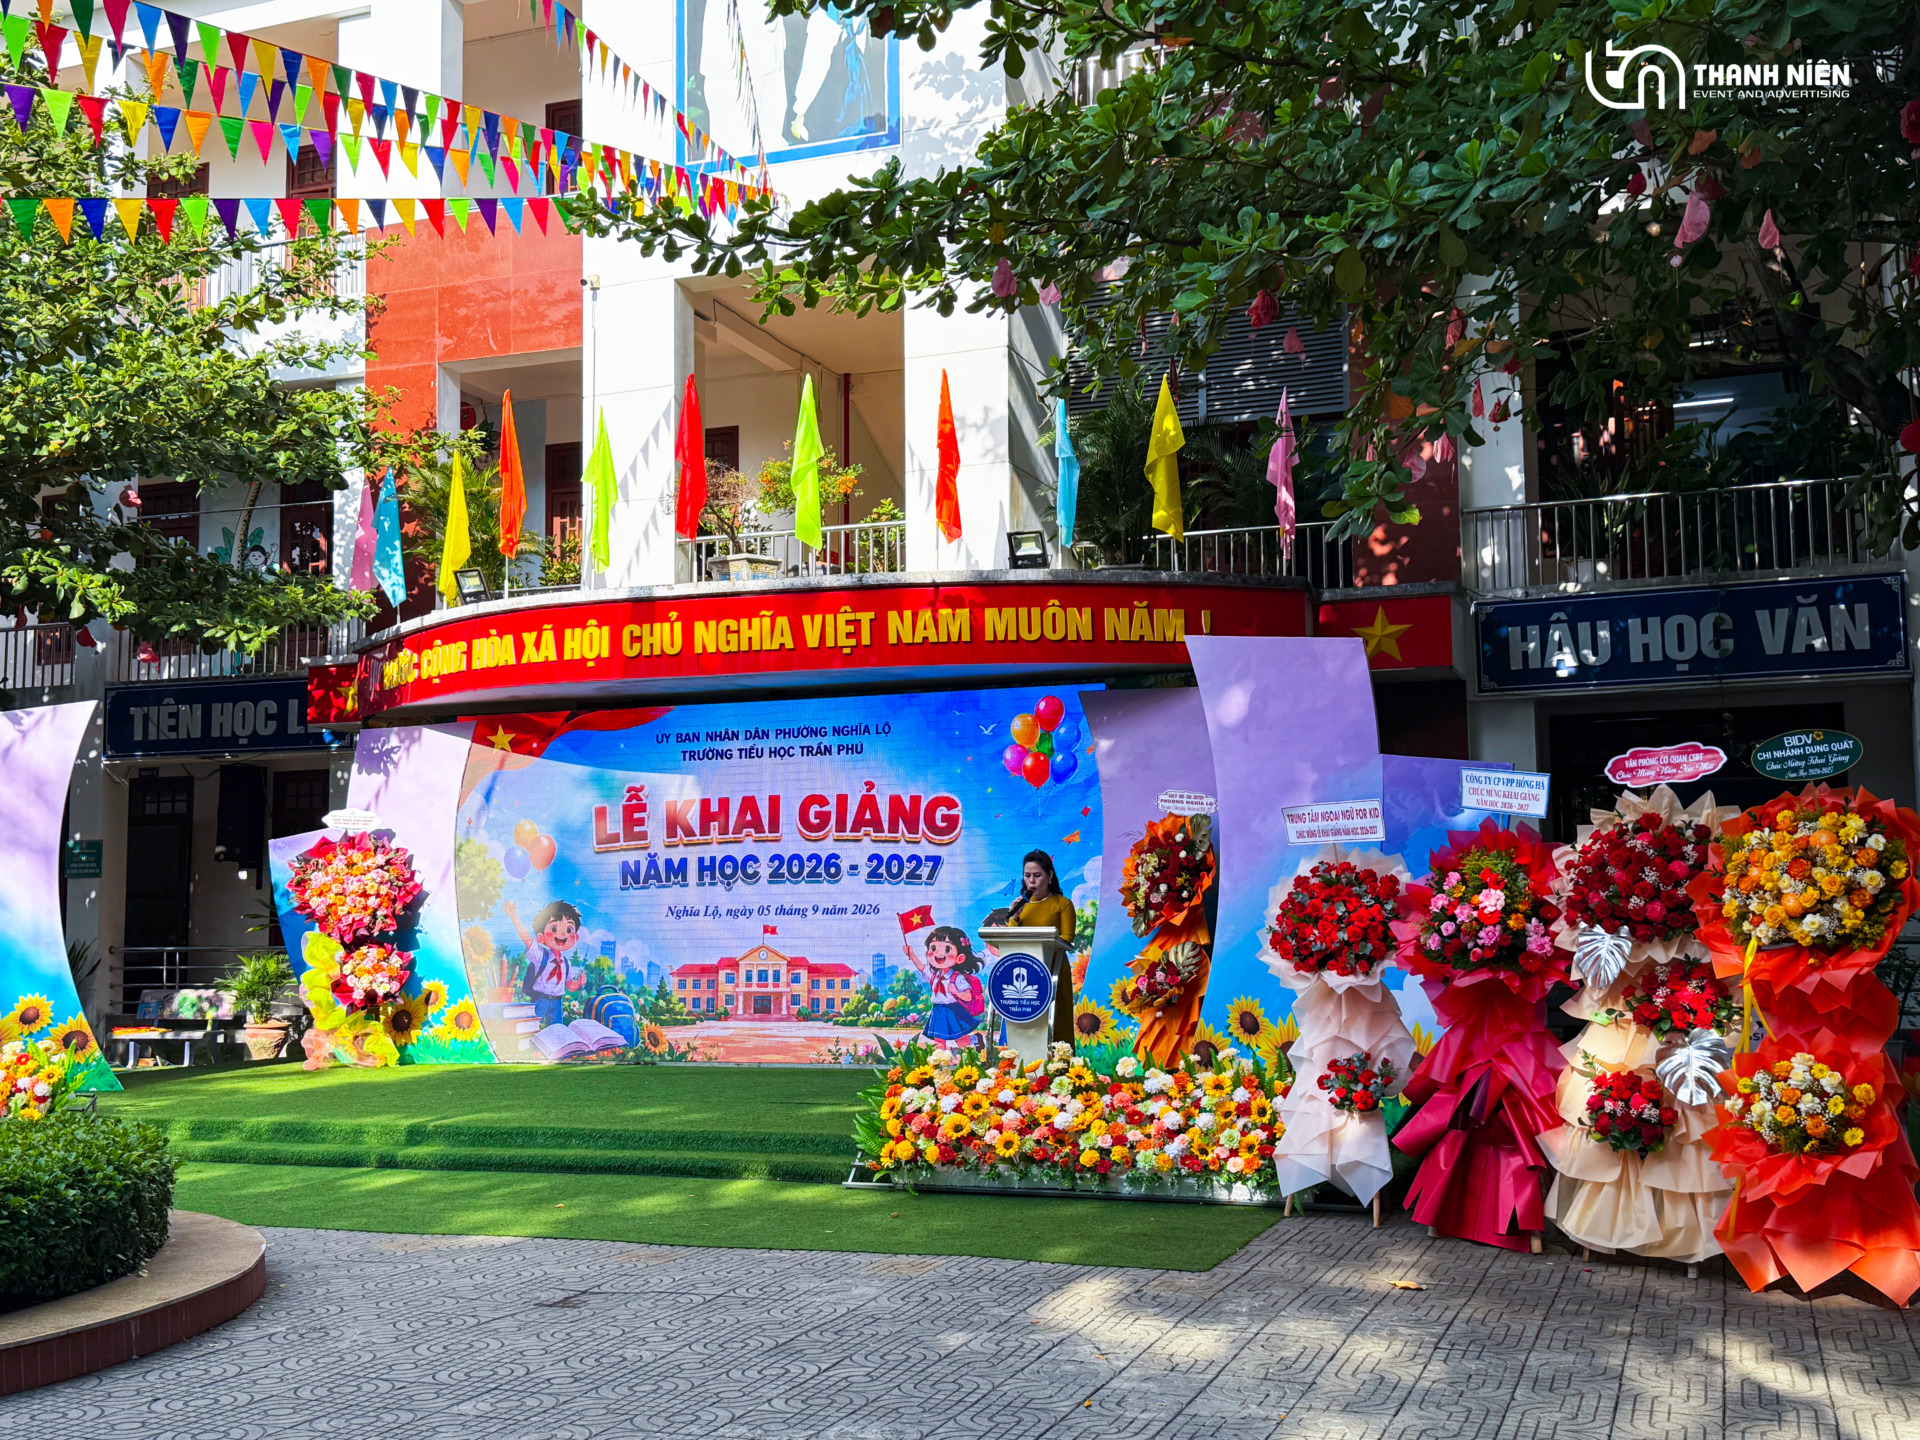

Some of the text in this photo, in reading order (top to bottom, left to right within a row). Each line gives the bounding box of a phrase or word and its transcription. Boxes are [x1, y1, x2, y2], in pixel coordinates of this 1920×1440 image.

[421, 640, 467, 684] CỘNG
[472, 629, 515, 670] HÒA
[521, 624, 556, 663] XÃ
[564, 619, 609, 667] HỘI
[622, 611, 682, 658] CHỦ
[694, 610, 794, 654] NGHĨA
[802, 606, 875, 654] VIỆT
[888, 608, 971, 644] NAM
[985, 599, 1093, 642] MUÔN
[1104, 600, 1186, 642] NĂM
[1628, 612, 1734, 671] HỌC
[1755, 595, 1871, 655] VĂN
[130, 698, 323, 744] TIÊN HỌC L
[656, 721, 891, 744] ỦY BAN NHÂN DÂN PHƯỜNG NGHĨA LỘ
[1783, 733, 1813, 747] BIDV
[681, 741, 864, 762] TRƯỜNG TIỂU HỌC TRẦN PHÚ
[1757, 739, 1854, 760] CHI NHÁNH DUNG QUẤT
[1625, 758, 1637, 768] VĂN
[1638, 757, 1658, 767] PHÒNG
[1669, 755, 1687, 764] QUAN
[1766, 760, 1782, 771] Chúc
[1465, 773, 1483, 784] CÔNG
[1484, 776, 1493, 785] TY
[1493, 777, 1501, 786] CP
[1501, 778, 1515, 787] VPP
[1468, 786, 1485, 796] CHÚC
[1502, 790, 1519, 800] KHAI
[1476, 798, 1488, 807] NĂM
[1500, 801, 1513, 810] 2026
[1517, 802, 1530, 811] 2027
[592, 780, 962, 853] LỄ KHAI GIẢNG
[1286, 813, 1307, 824] TRUNG
[1307, 809, 1320, 823] TÂM
[1321, 810, 1340, 825] NGOẠI
[1355, 808, 1368, 820] FOR
[1369, 807, 1379, 819] KID
[619, 852, 944, 891] NĂM HỌC 2026 - 2027
[665, 903, 880, 920] Nghĩa Lộ, ngày 05 tháng 9 năm 2026
